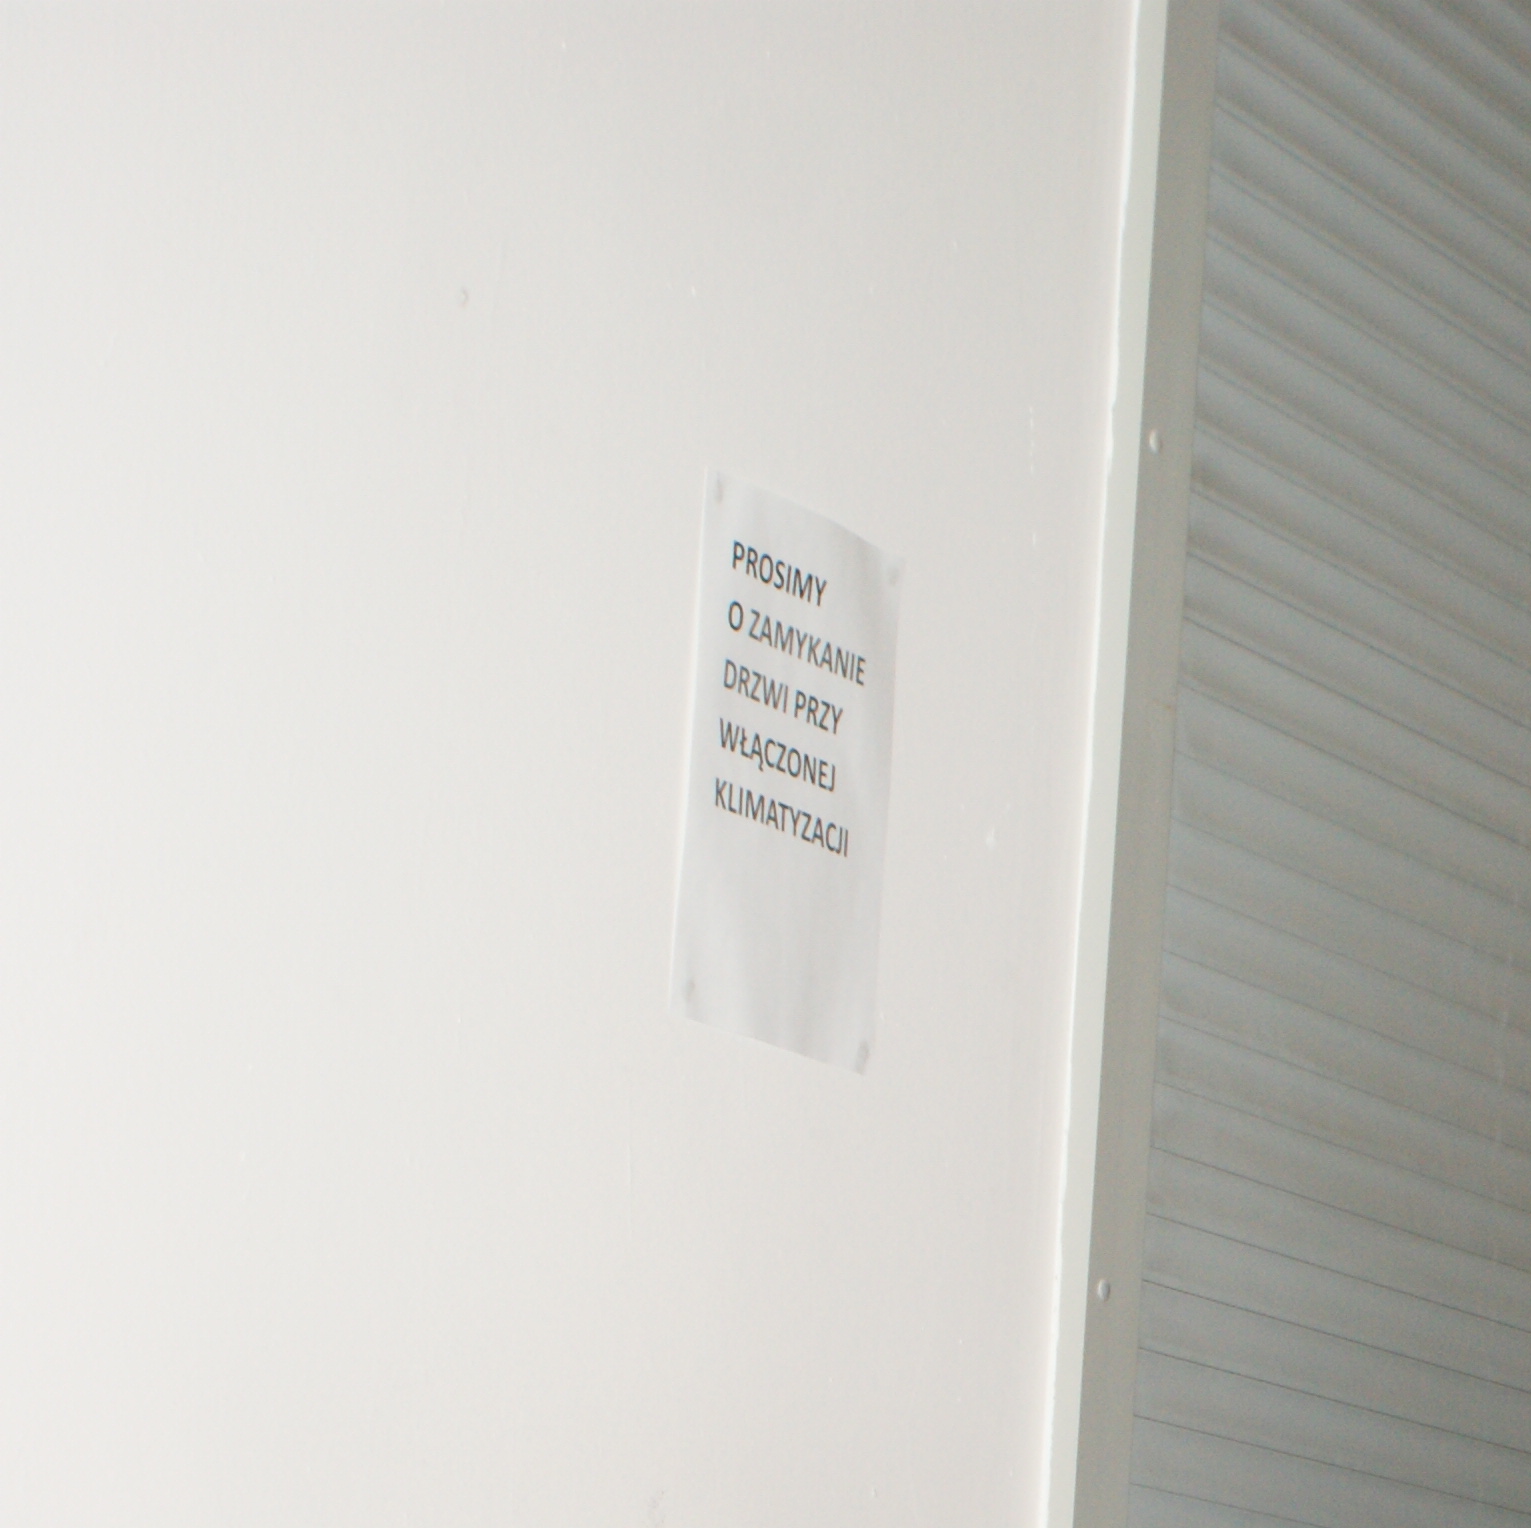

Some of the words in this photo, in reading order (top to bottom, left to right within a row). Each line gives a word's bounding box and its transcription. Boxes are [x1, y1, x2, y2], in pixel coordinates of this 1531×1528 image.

[732, 541, 827, 607] PROSIMY
[729, 601, 745, 632] O
[748, 609, 867, 686] ZAMYKANIE
[723, 659, 790, 715] DRZWI
[795, 690, 844, 737] PRZY
[719, 718, 838, 793] WŁĄCZONEJ
[715, 778, 850, 858] KLIMATYZACJI
